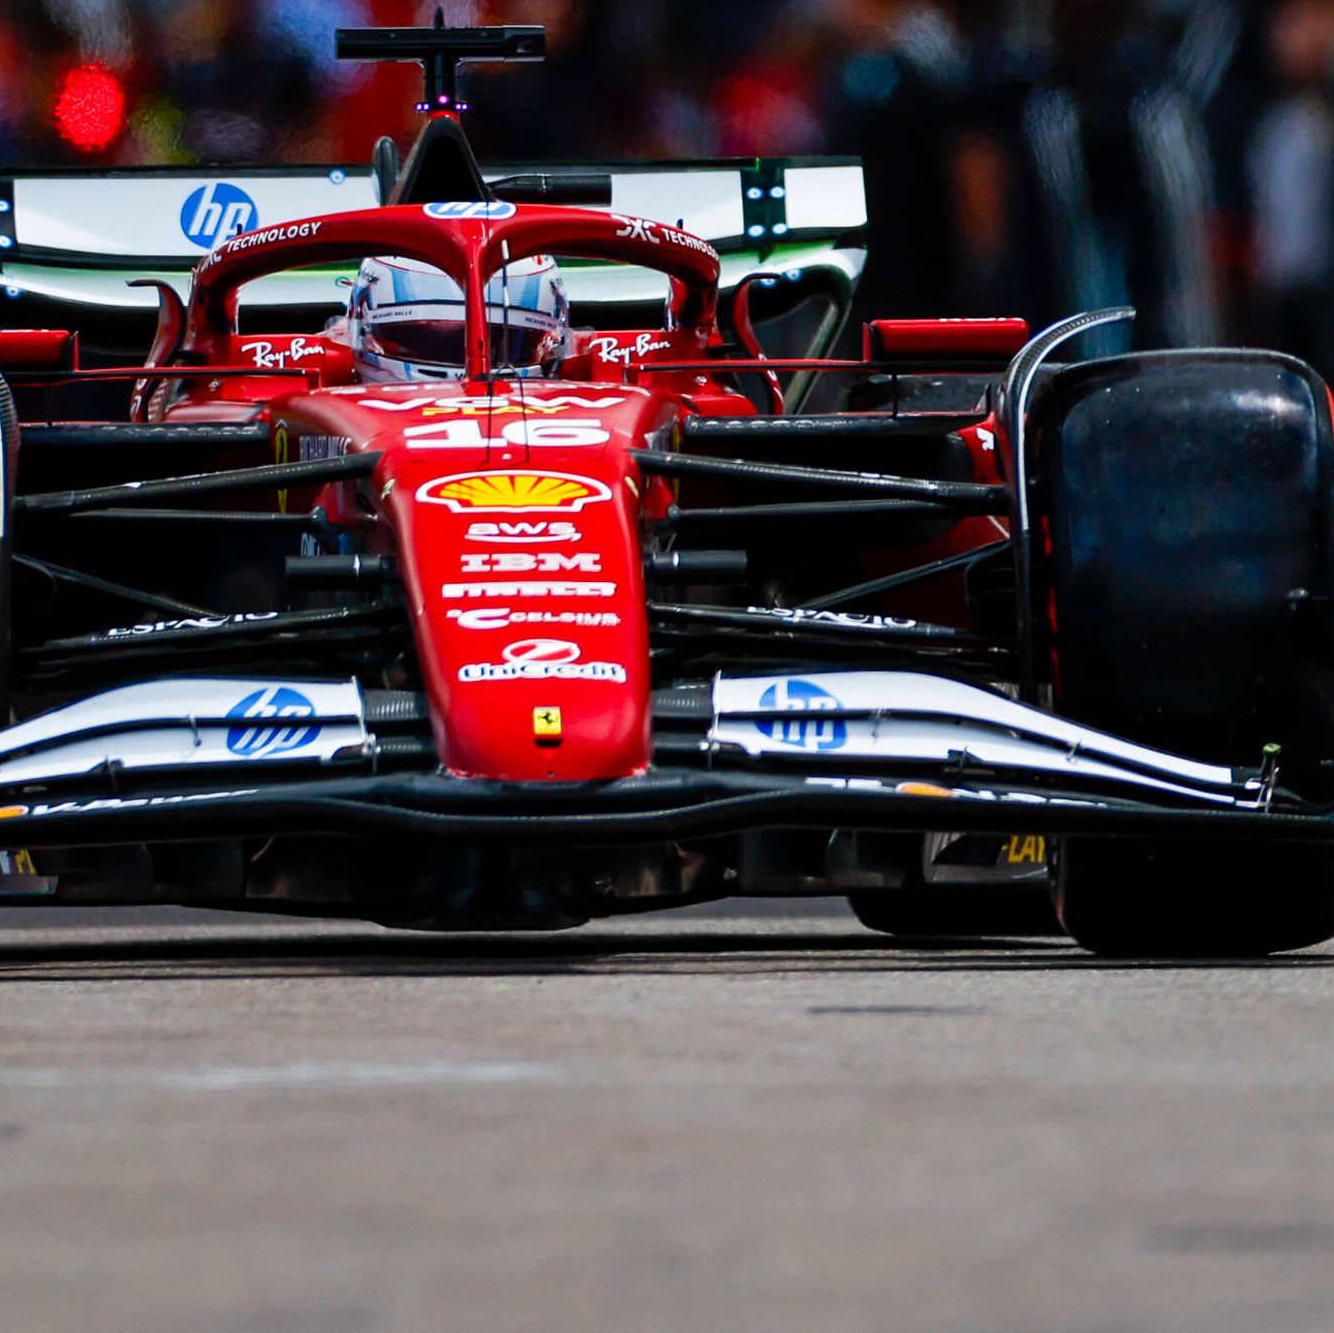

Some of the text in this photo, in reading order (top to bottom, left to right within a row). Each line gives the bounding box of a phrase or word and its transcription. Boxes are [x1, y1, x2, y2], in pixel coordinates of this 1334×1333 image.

[186, 183, 255, 251] hp
[227, 222, 322, 253] TECHNOLOGY
[241, 338, 324, 368] Ray-Ban
[589, 334, 671, 364] Ray-Ban
[421, 405, 570, 416] PLAY
[403, 419, 611, 448] 16
[466, 522, 578, 537] aws
[460, 553, 602, 572] IBM
[459, 663, 626, 682] UniCredit
[231, 687, 314, 758] hp
[768, 678, 840, 751] hp
